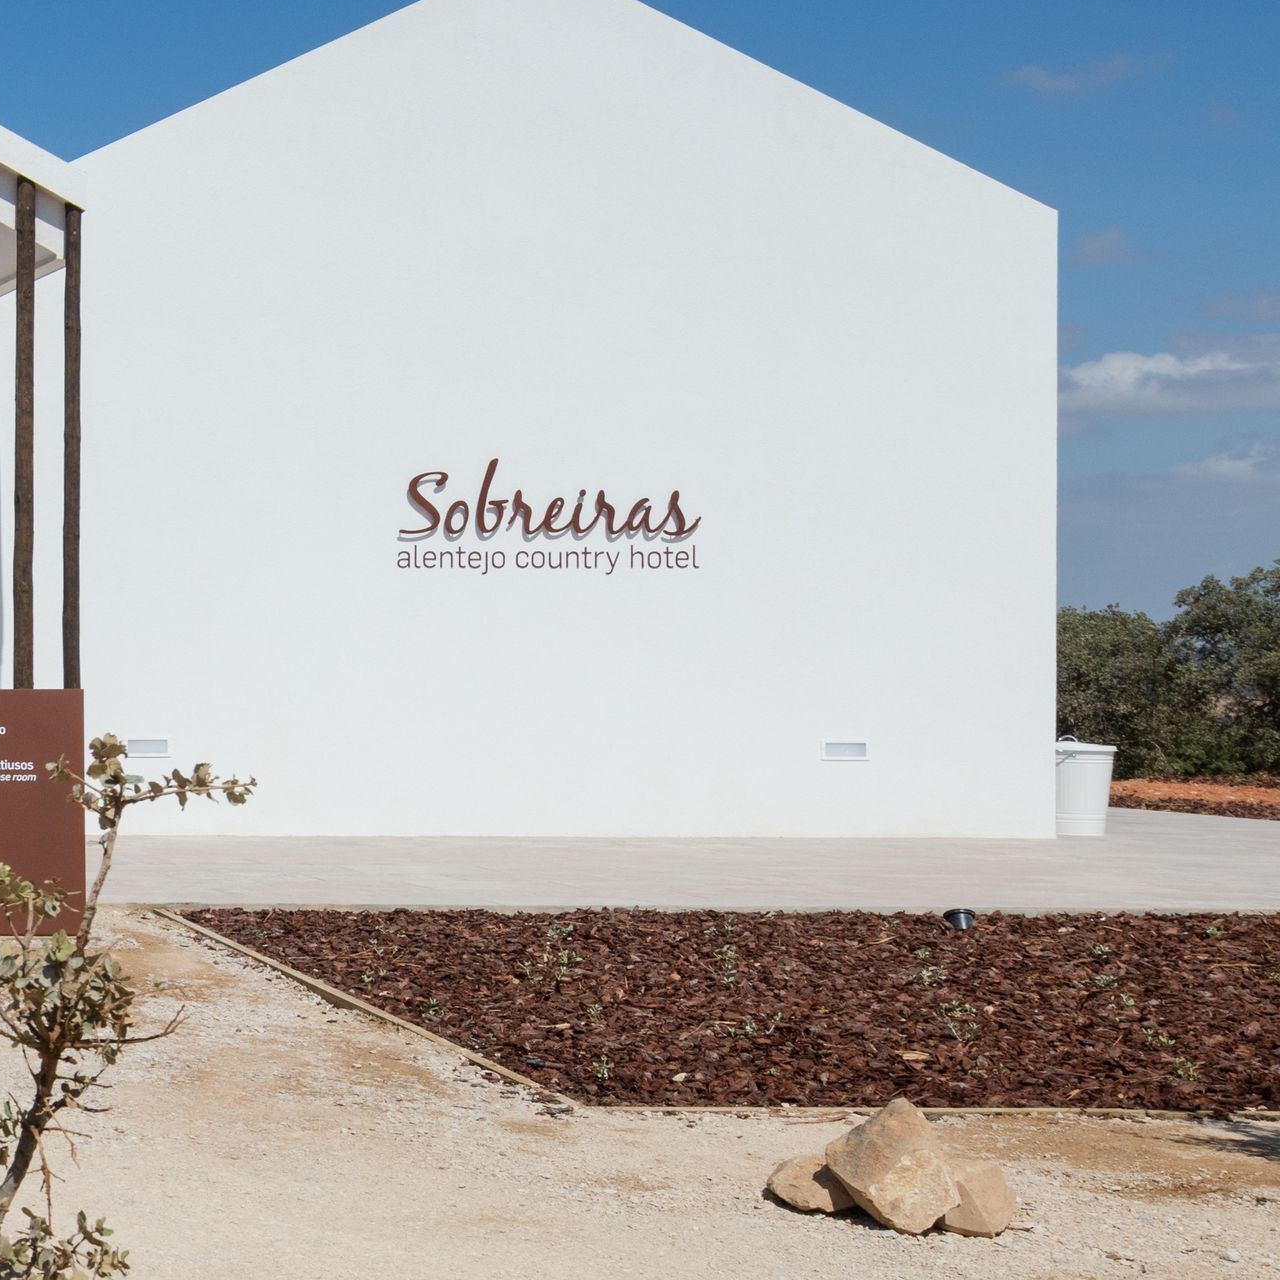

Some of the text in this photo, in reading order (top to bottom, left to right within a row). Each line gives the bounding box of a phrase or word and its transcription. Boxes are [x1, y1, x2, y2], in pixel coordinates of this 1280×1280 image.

[398, 458, 702, 538] Sobreiras
[396, 544, 700, 575] alentejo country hotel
[12, 774, 37, 782] room
